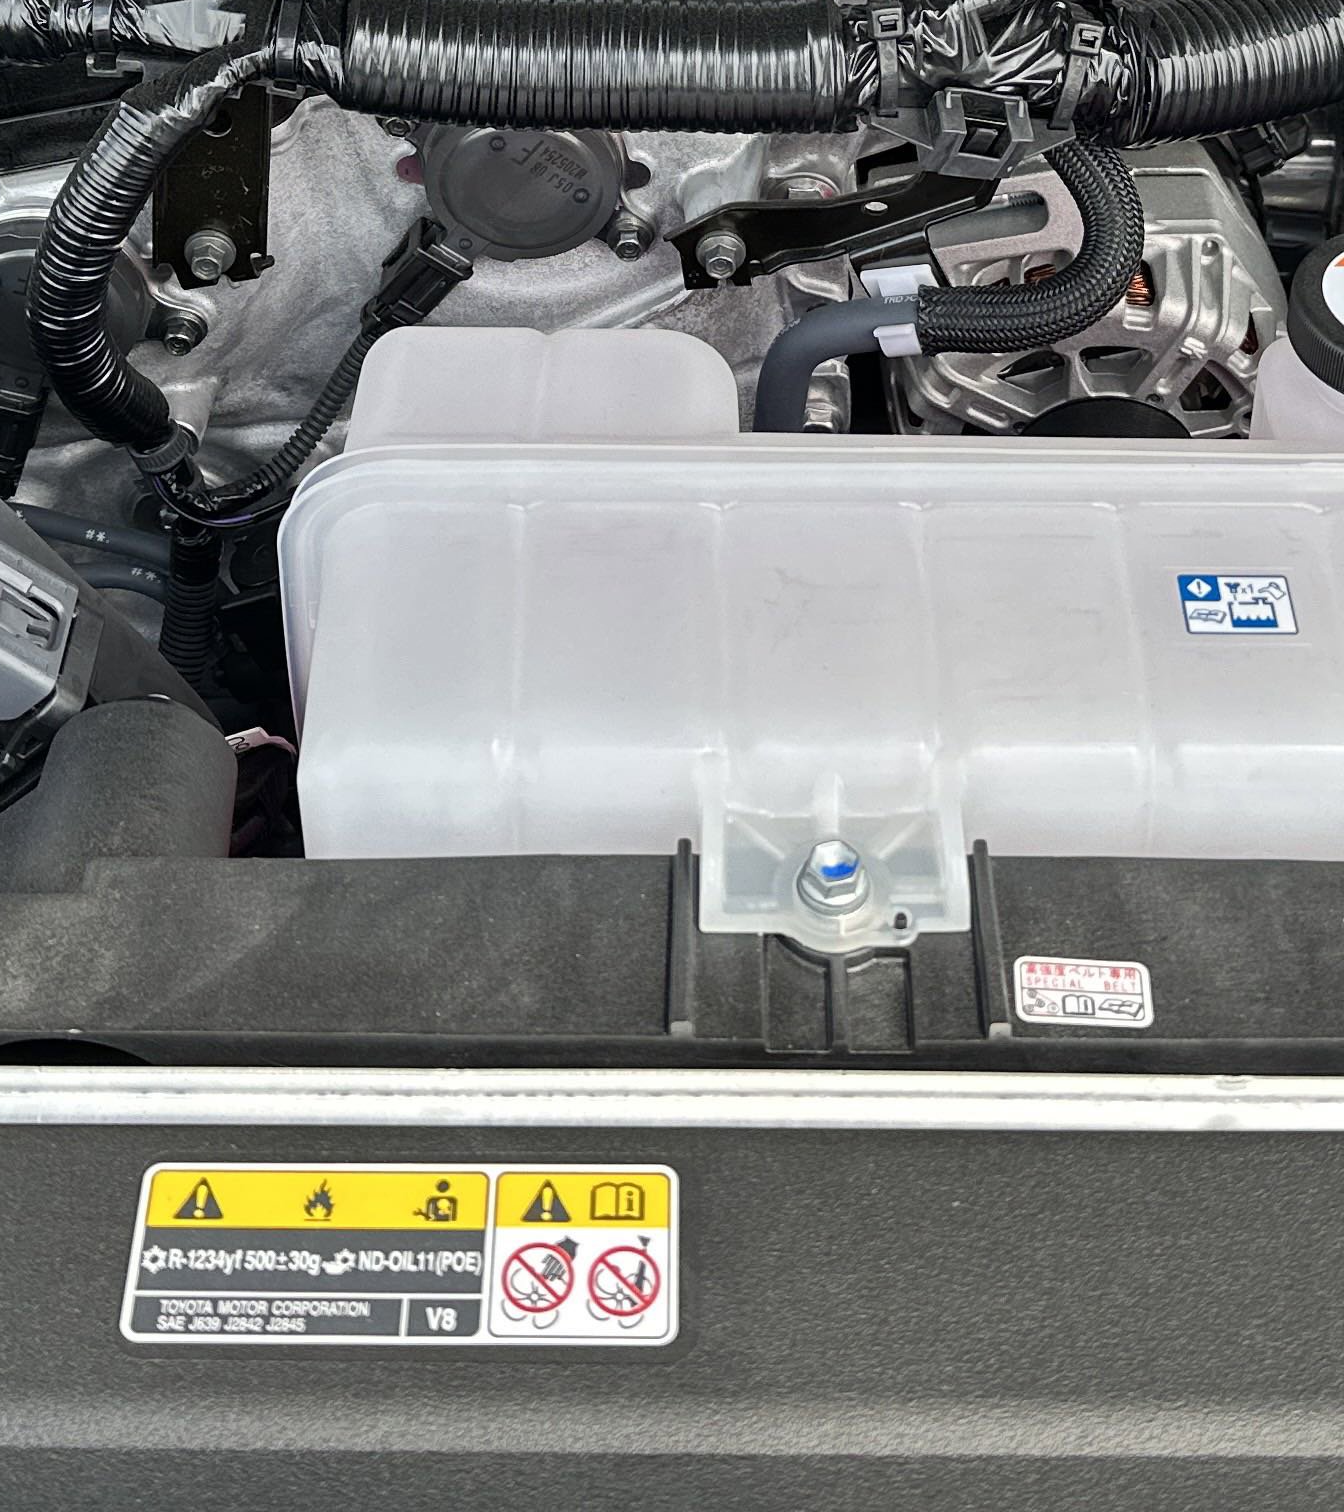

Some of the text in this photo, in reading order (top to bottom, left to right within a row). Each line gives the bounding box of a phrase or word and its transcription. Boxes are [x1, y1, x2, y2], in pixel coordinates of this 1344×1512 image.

[1026, 976, 1137, 993] SPECIAL BELT
[167, 1248, 482, 1277] R-1234yf 500±30g ND-OIL11(POE)
[159, 1299, 371, 1317] TOYOTA MOTOR CORPORATION
[156, 1315, 186, 1331] SAE
[188, 1316, 222, 1332] J639
[223, 1316, 264, 1332] J2842
[425, 1307, 458, 1332] V8
